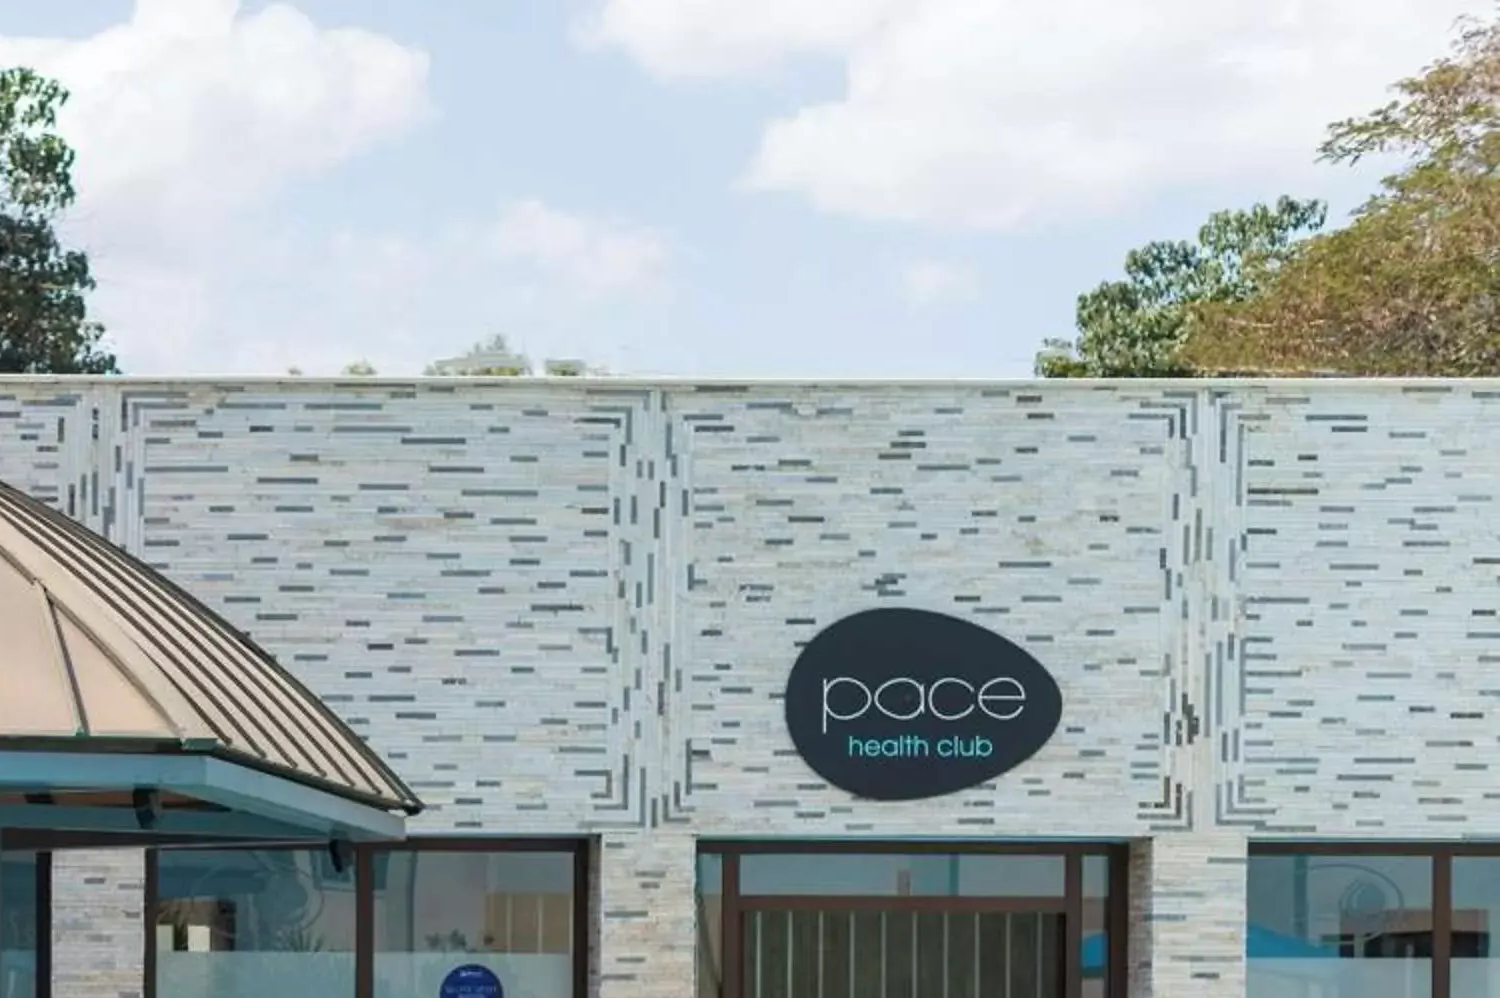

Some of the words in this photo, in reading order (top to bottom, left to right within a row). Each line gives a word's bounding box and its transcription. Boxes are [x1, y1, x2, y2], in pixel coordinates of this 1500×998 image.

[822, 677, 1027, 734] pace
[848, 735, 930, 757] health
[936, 735, 994, 757] club
